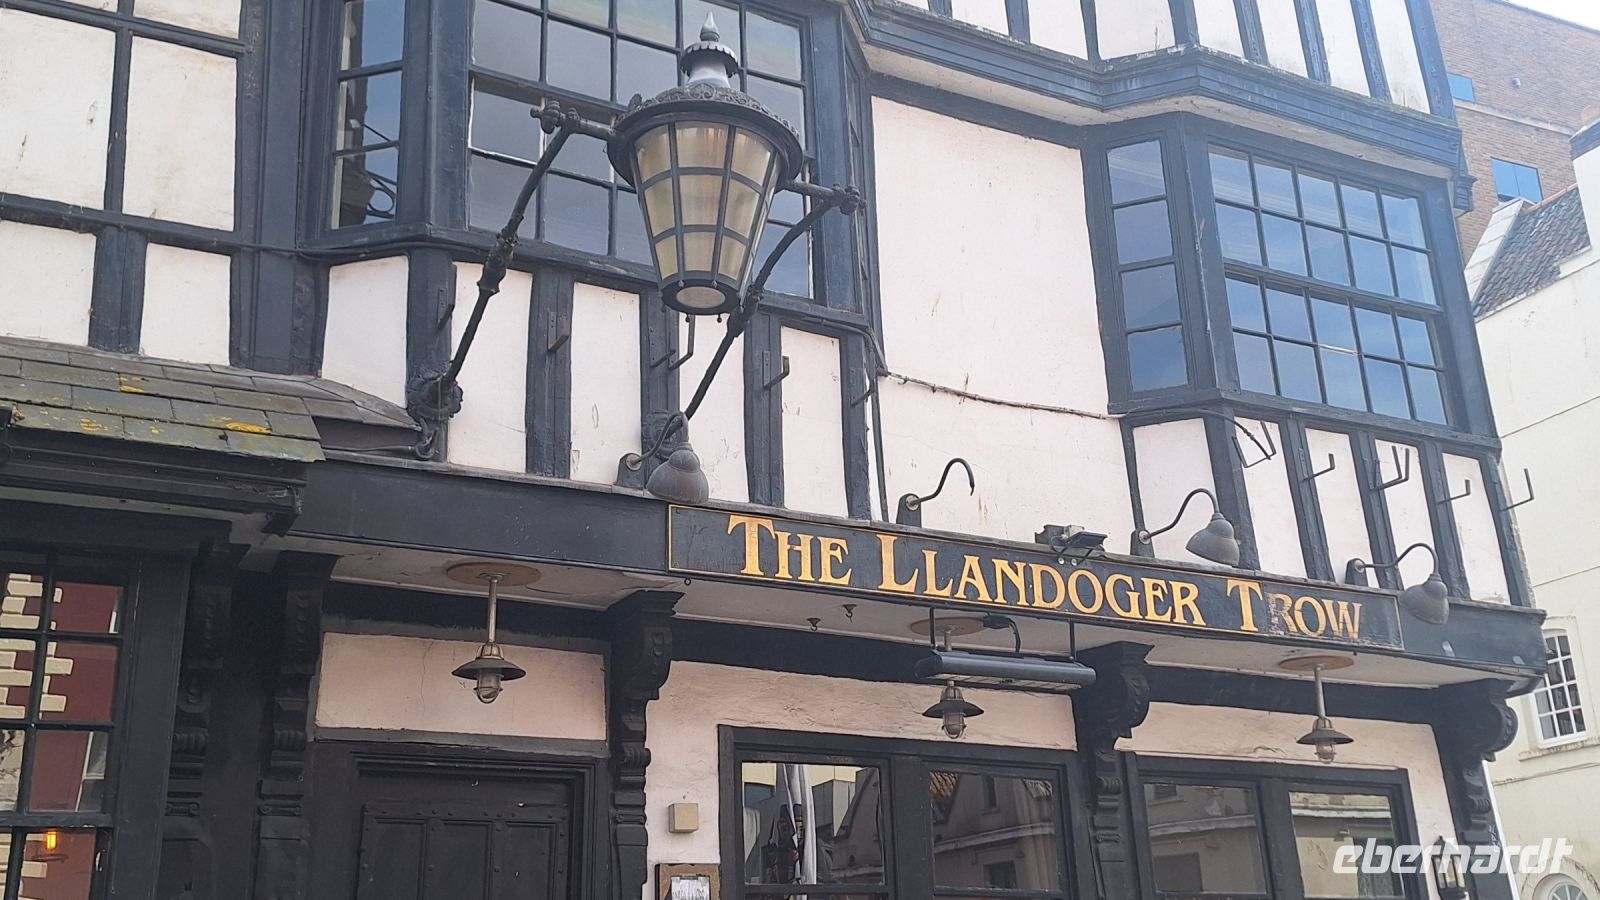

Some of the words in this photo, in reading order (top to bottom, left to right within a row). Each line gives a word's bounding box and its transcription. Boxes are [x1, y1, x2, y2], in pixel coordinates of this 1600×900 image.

[727, 514, 852, 585] THE
[876, 533, 1206, 627] LLANDOGER
[1227, 578, 1363, 641] TROW
